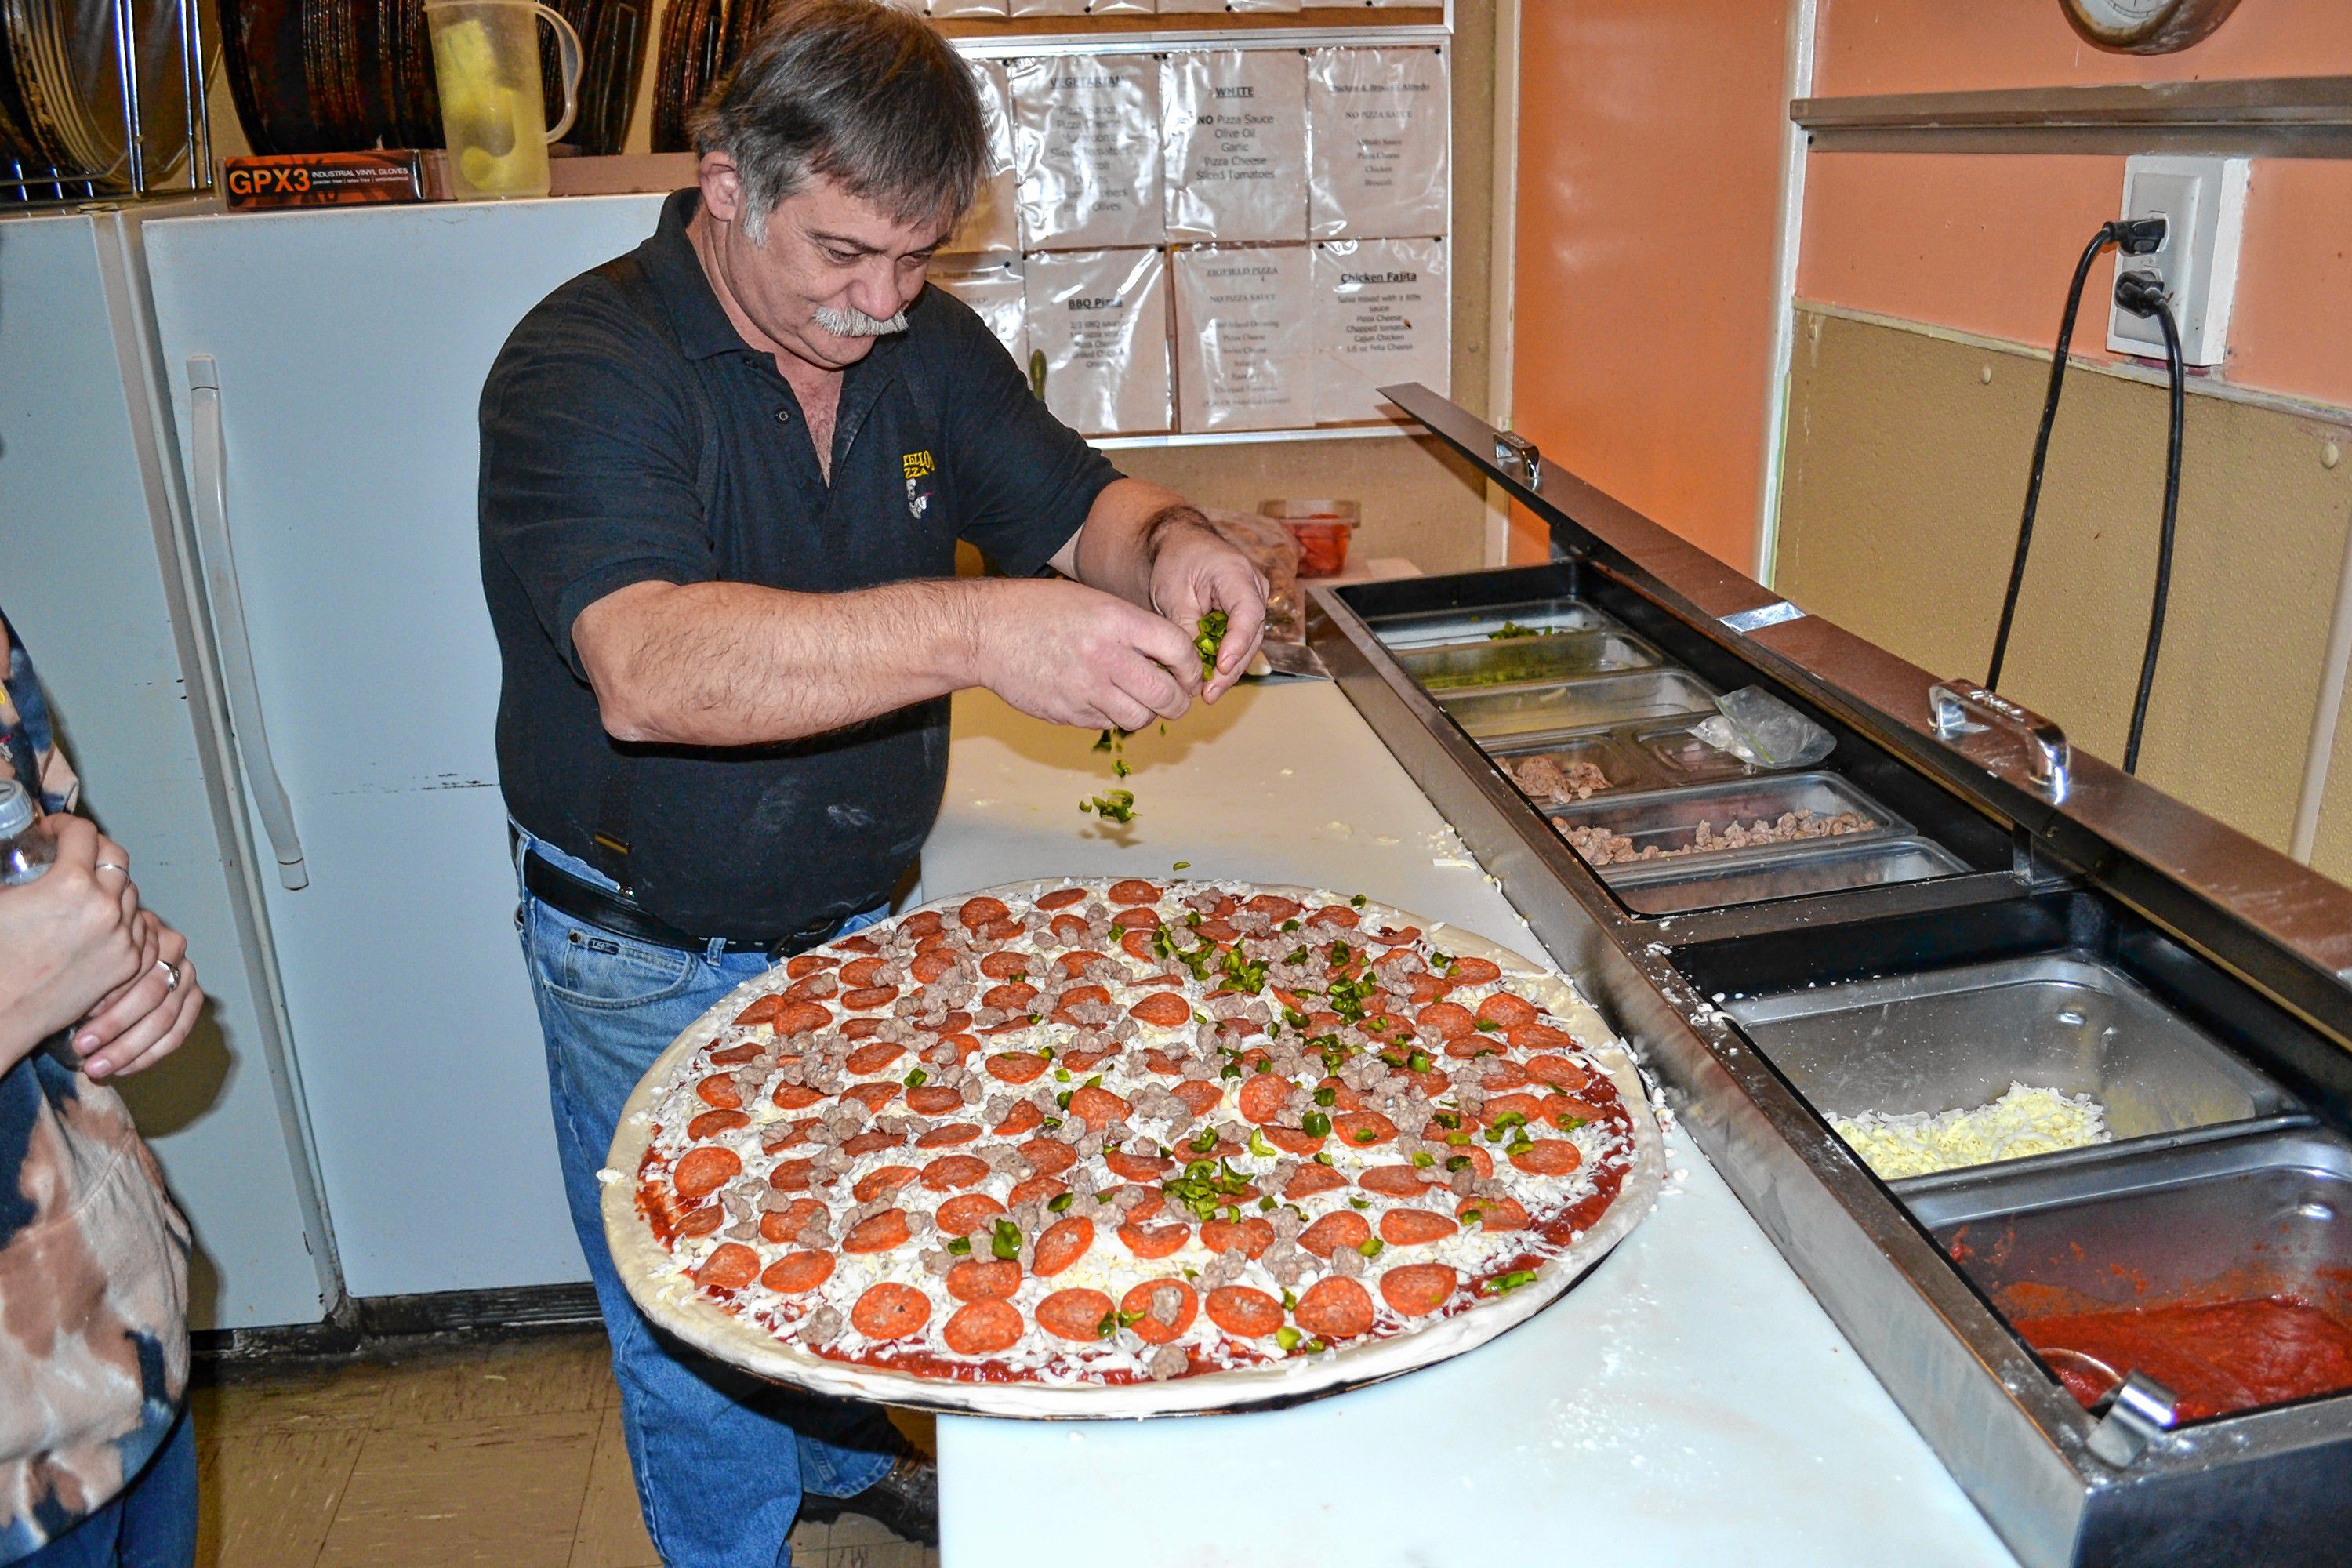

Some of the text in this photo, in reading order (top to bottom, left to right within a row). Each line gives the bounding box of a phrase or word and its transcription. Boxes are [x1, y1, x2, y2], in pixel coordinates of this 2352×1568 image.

[1215, 86, 1254, 97] WHITE
[1197, 113, 1274, 124] NO Pizza Sauce
[1214, 128, 1256, 138] Olive Oil
[1221, 142, 1249, 152] Garlic
[1204, 156, 1267, 166] Pizza Cheese
[1196, 169, 1275, 180] Sliced Tomatoes
[230, 168, 310, 195] GPX3
[1341, 271, 1417, 283] Chicken Fajita
[1069, 298, 1123, 309] BBQ Piza
